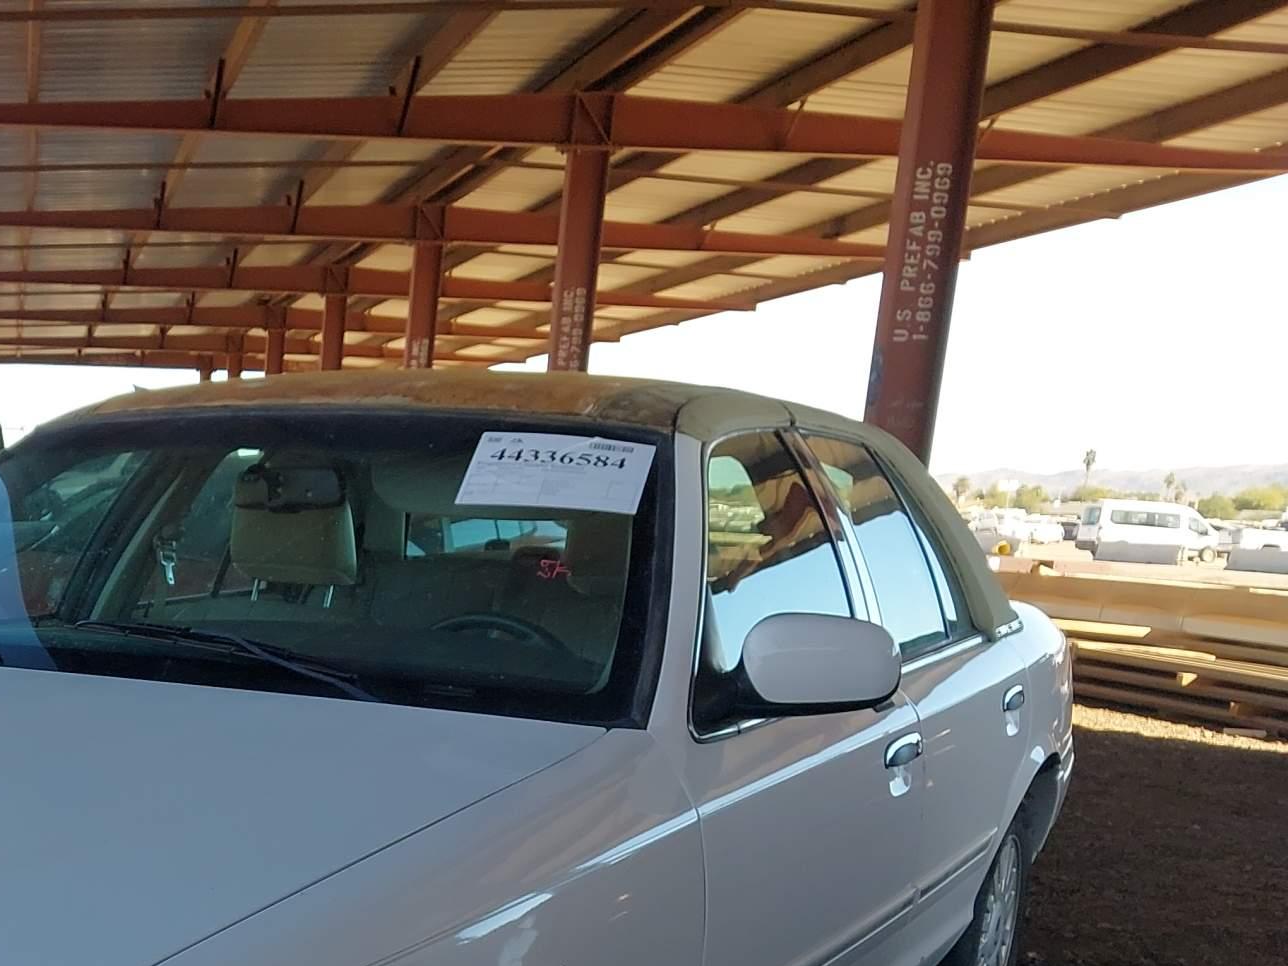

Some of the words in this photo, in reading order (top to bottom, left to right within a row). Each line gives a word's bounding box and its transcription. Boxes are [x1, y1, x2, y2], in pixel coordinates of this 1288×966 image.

[900, 211, 926, 291] PREFAB
[913, 161, 934, 200] INC.
[912, 163, 952, 341] 1-866-799-0969
[490, 447, 627, 469] 44336584
